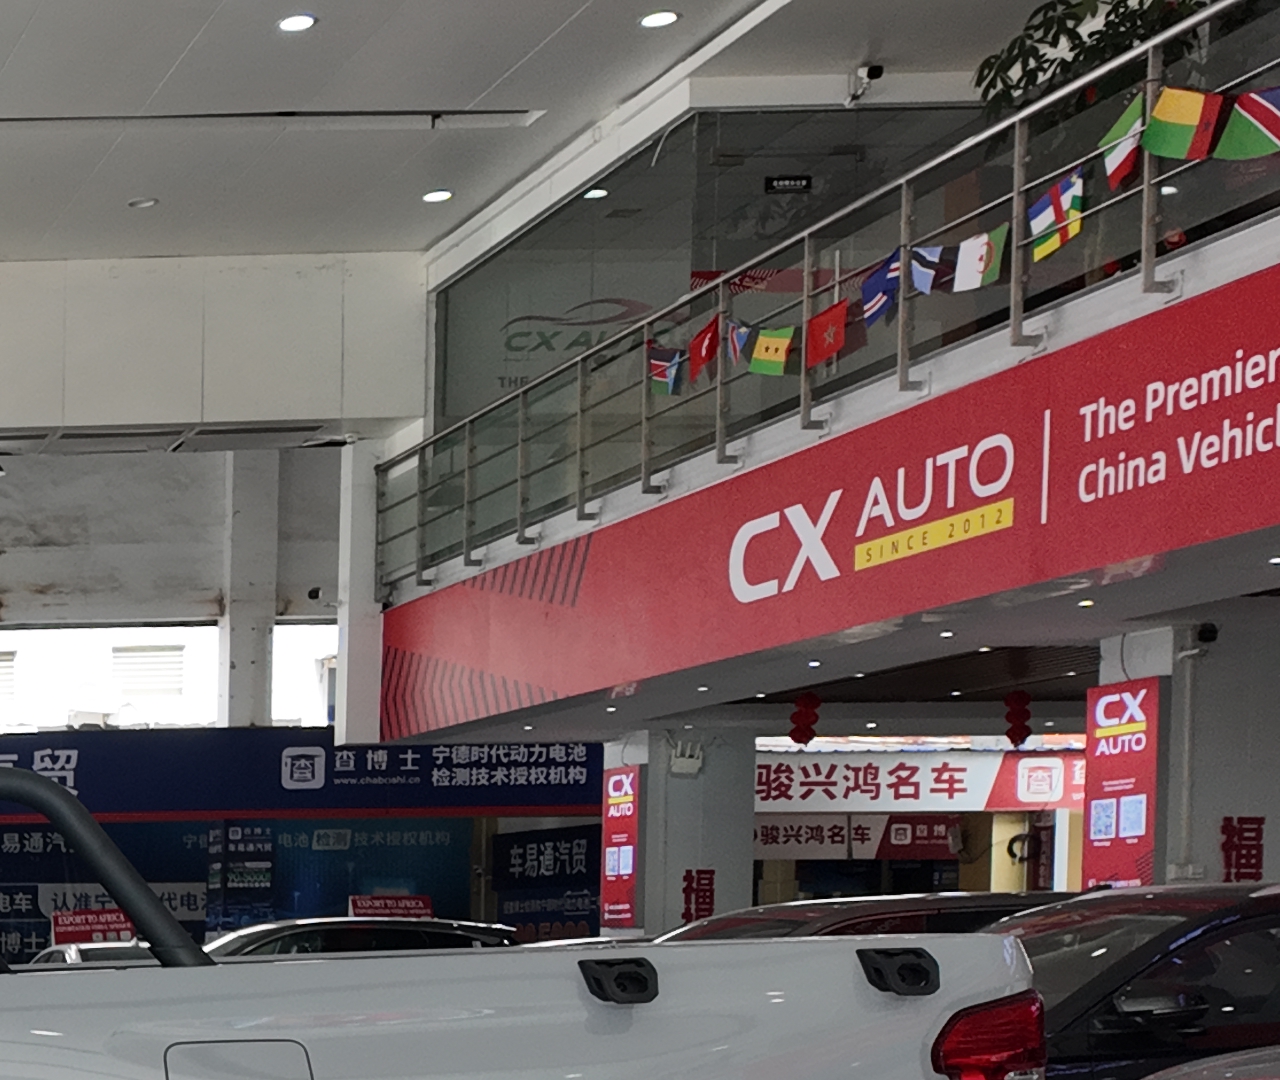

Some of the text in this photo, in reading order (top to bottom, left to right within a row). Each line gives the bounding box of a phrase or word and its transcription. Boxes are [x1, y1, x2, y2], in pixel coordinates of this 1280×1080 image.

[1078, 347, 1280, 443] The Premier
[1078, 451, 1167, 503] China
[729, 433, 1014, 604] CX AUTO
[866, 508, 1003, 562] SINCE 2012
[1095, 689, 1147, 727] CX
[334, 744, 587, 771] 查博士 宁德时代动力电池
[1095, 733, 1146, 756] AUTO
[431, 767, 587, 786] 检测技术授权机构
[608, 773, 634, 797] CX
[755, 762, 968, 802] 骏兴鸿名车
[608, 803, 634, 817] AUTO
[761, 824, 872, 846] 骏兴鸿名车
[1221, 816, 1266, 882] 福
[509, 838, 588, 878] 车易通汽贸
[681, 869, 716, 923] 福
[58, 915, 86, 925] EXPORT
[87, 915, 98, 924] TO
